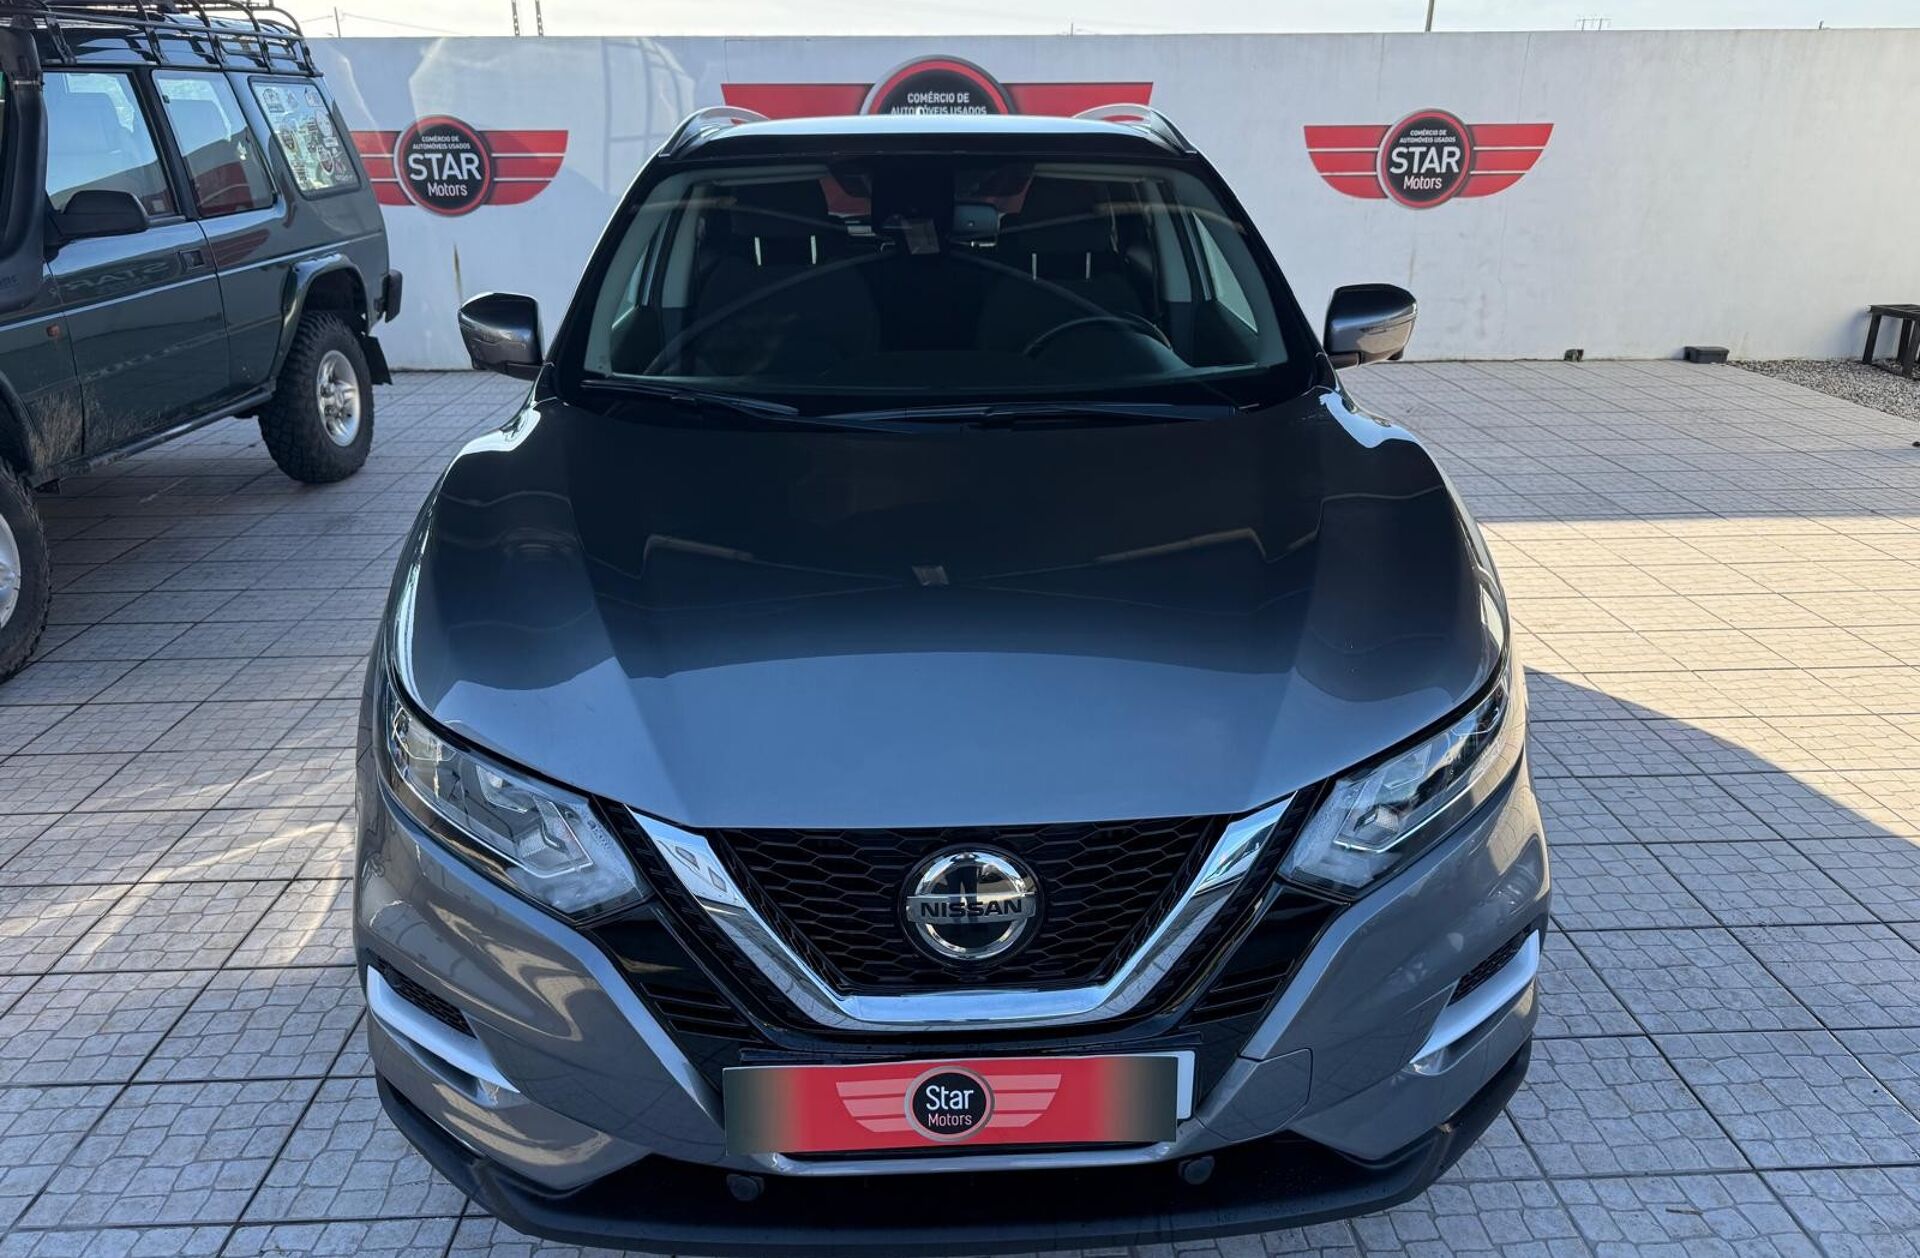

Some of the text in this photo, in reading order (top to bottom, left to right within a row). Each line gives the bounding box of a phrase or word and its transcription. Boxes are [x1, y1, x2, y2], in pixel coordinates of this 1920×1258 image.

[907, 90, 970, 103] COMÉRCIO DE
[950, 105, 987, 115] USADOS
[1409, 128, 1438, 136] COMÉRCIO
[412, 142, 471, 150] AUTOMÓVEIS USADOS
[1399, 136, 1433, 144] AUTOMÓVEIS
[407, 152, 482, 180] STAR
[1389, 146, 1461, 174] STAR
[427, 182, 468, 197] Motors
[1403, 175, 1442, 190] Motors
[920, 899, 1022, 918] NISSAN
